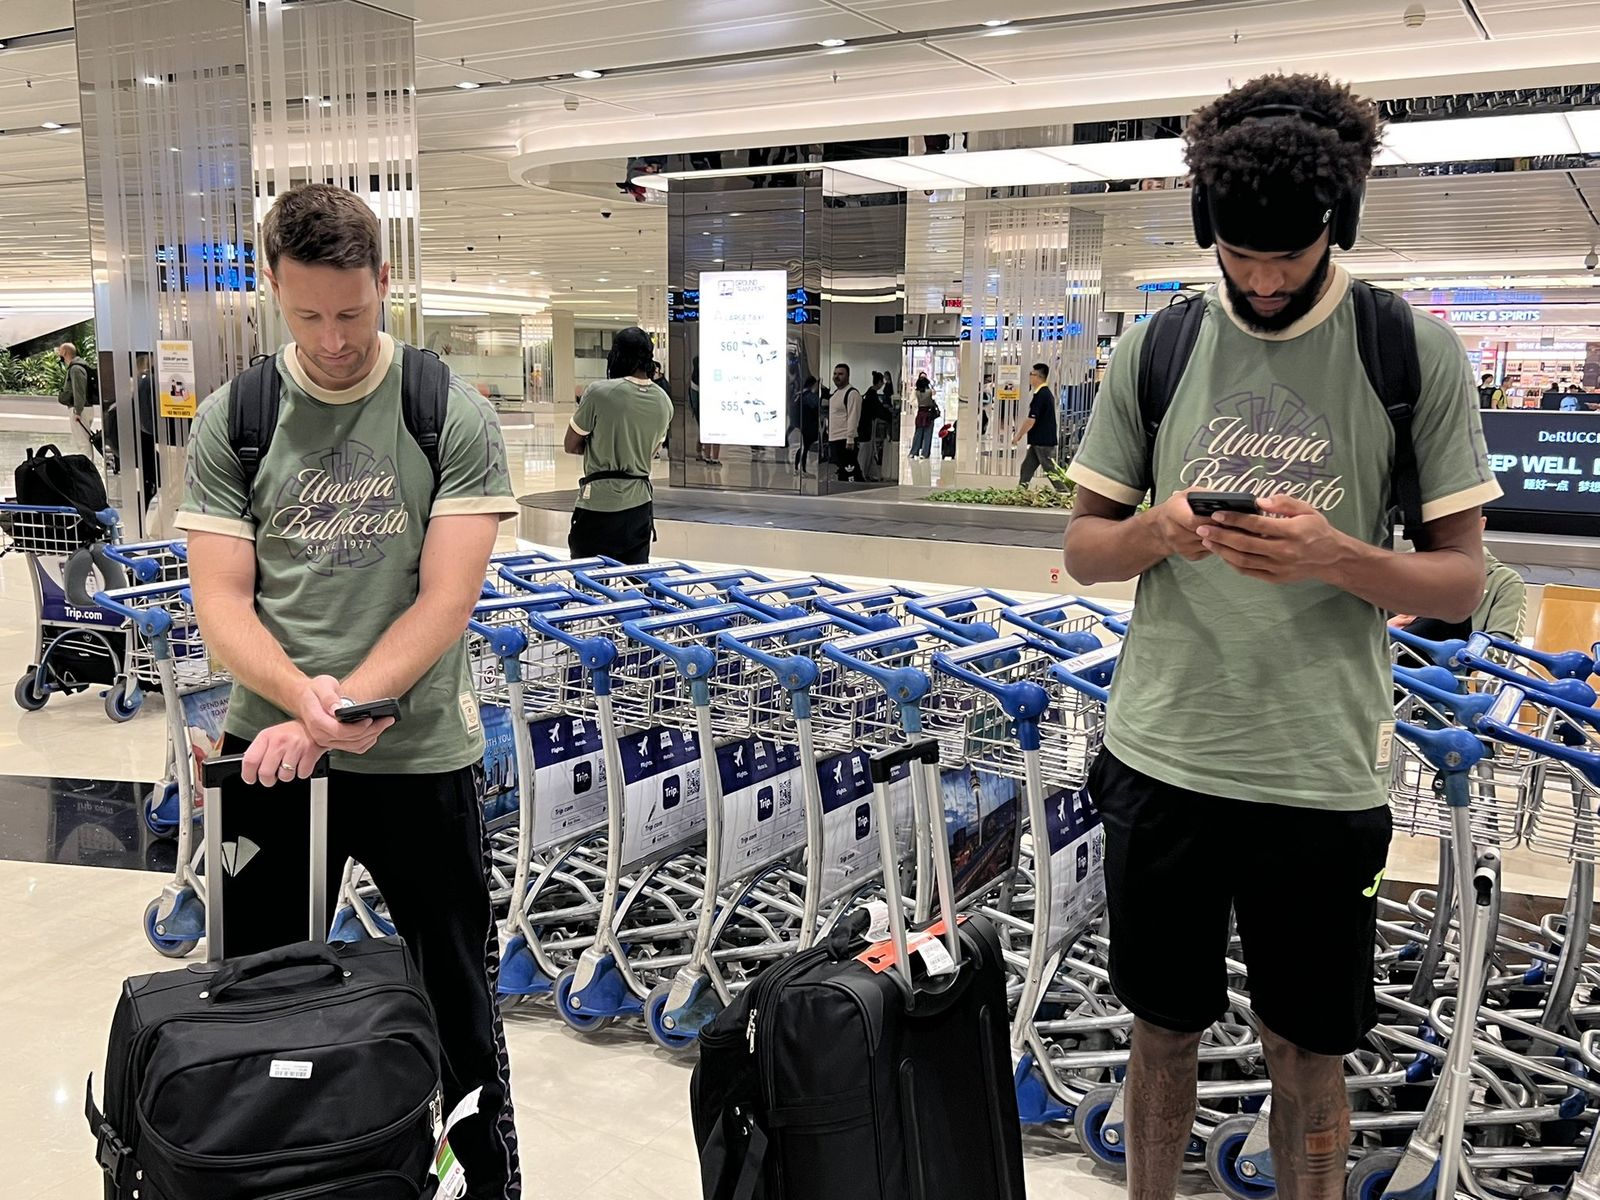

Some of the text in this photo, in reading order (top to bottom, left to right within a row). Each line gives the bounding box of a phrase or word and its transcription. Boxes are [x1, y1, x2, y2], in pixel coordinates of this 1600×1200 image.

[1450, 310, 1540, 321] WINES & SPIRITS
[720, 341, 738, 352] $60
[721, 401, 739, 411] $55
[1207, 416, 1331, 476] Unicaja
[1521, 455, 1582, 475] WELL
[297, 468, 396, 514] Unicaja
[306, 540, 372, 555] SINE 1977
[64, 606, 103, 621] Trip.com
[199, 702, 220, 712] SPEND
[211, 709, 221, 717] TO
[498, 734, 512, 744] YOU
[664, 787, 679, 798] Trip.
[759, 798, 772, 809] Trip.
